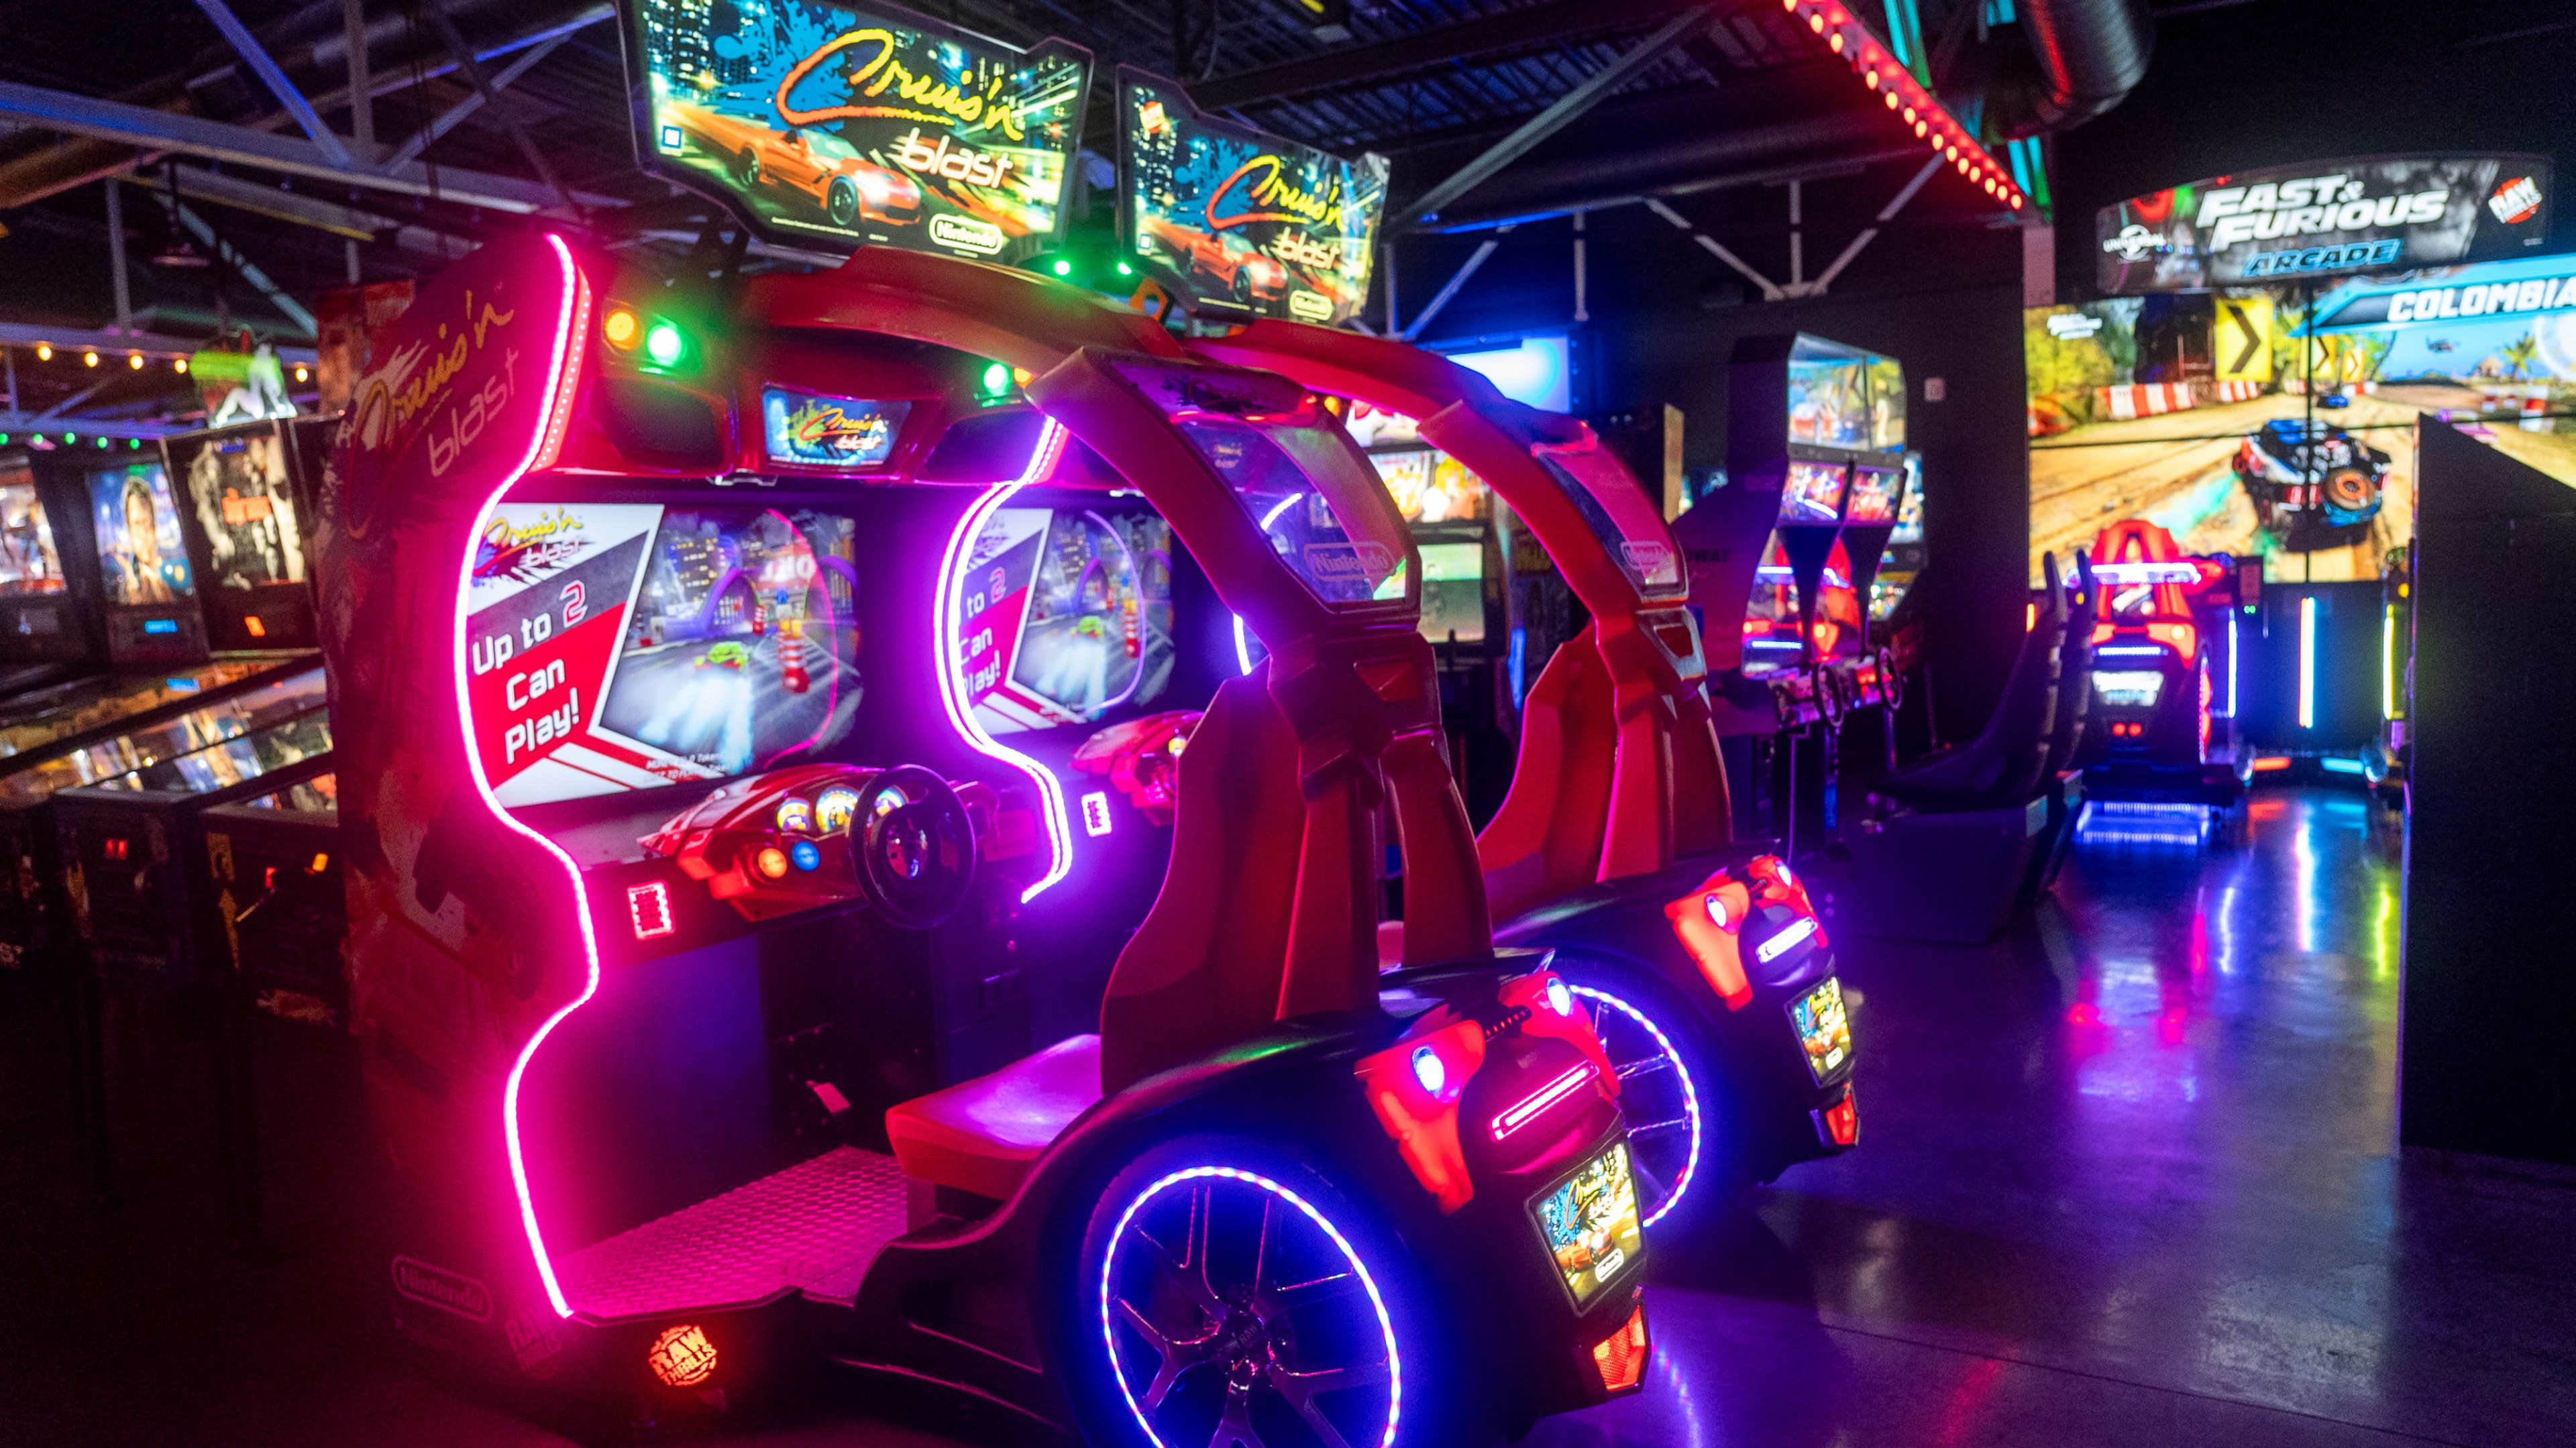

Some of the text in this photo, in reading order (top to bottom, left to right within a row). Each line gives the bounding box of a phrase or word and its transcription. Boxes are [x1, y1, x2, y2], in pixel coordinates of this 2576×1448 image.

[776, 29, 1024, 141] Cruis'n
[896, 127, 1014, 190] blast
[1206, 154, 1347, 232] Cruis'n
[936, 220, 998, 248] Nintendo
[2208, 190, 2450, 252] FURIOUS
[1272, 226, 1341, 270] blast
[2242, 239, 2403, 277] ARCADE
[2387, 276, 2576, 323] COLOMBIA
[428, 347, 519, 478] blast
[518, 539, 581, 567] blast
[1312, 546, 1389, 571] Nintendo
[967, 567, 1007, 618] to 2
[472, 579, 588, 676] Up to 2
[506, 659, 566, 712] Can
[505, 687, 580, 765] Play!
[400, 1265, 484, 1311] Nintendo
[651, 1325, 706, 1377] RAW
[659, 1344, 717, 1386] THRILLS
